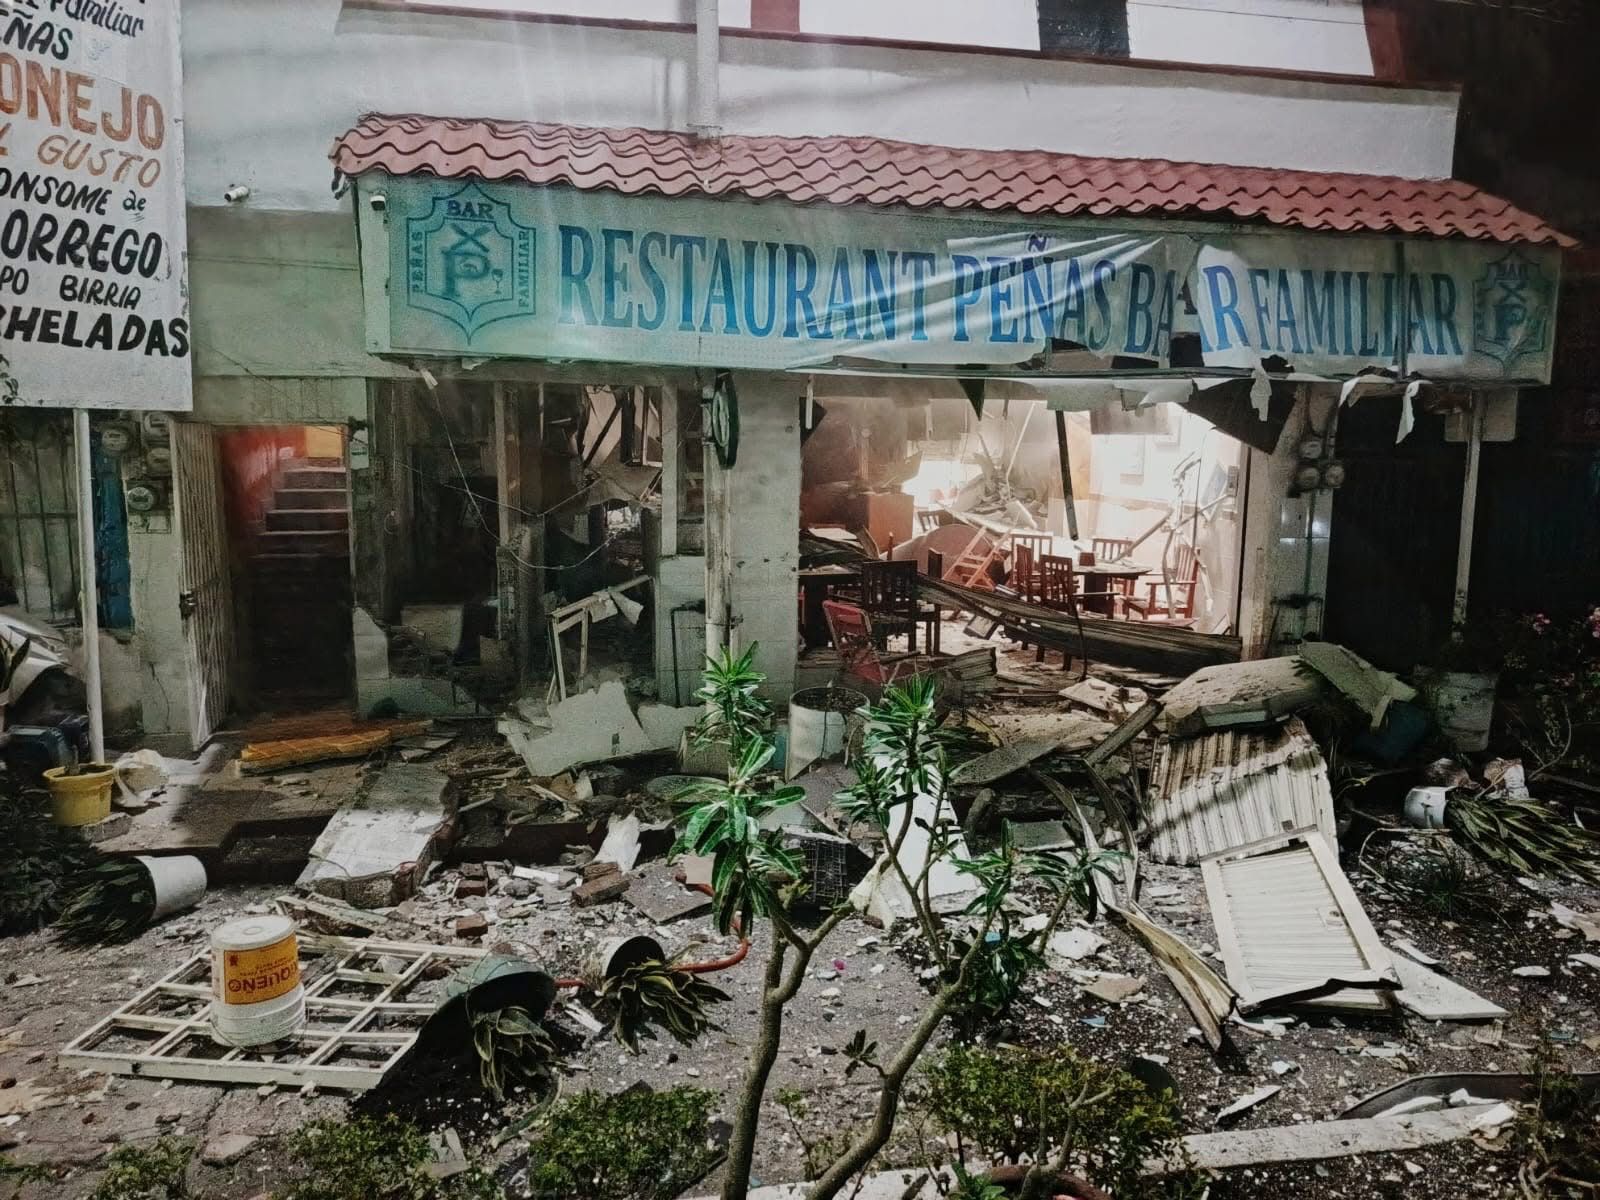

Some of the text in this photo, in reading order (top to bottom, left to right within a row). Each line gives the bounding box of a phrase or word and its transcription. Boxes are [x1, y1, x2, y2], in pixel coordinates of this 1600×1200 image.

[0, 9, 73, 60] ÑAS
[37, 134, 161, 188] GUSTO
[122, 190, 146, 211] de
[447, 200, 495, 219] BAR
[59, 274, 141, 310] BIRRIA
[518, 230, 530, 308] FAMILIAR
[557, 224, 936, 342] RESTAURANT
[951, 232, 1117, 351] PEÑAS
[1246, 267, 1464, 358] FAMILIAR
[0, 305, 189, 357] HELADAS
